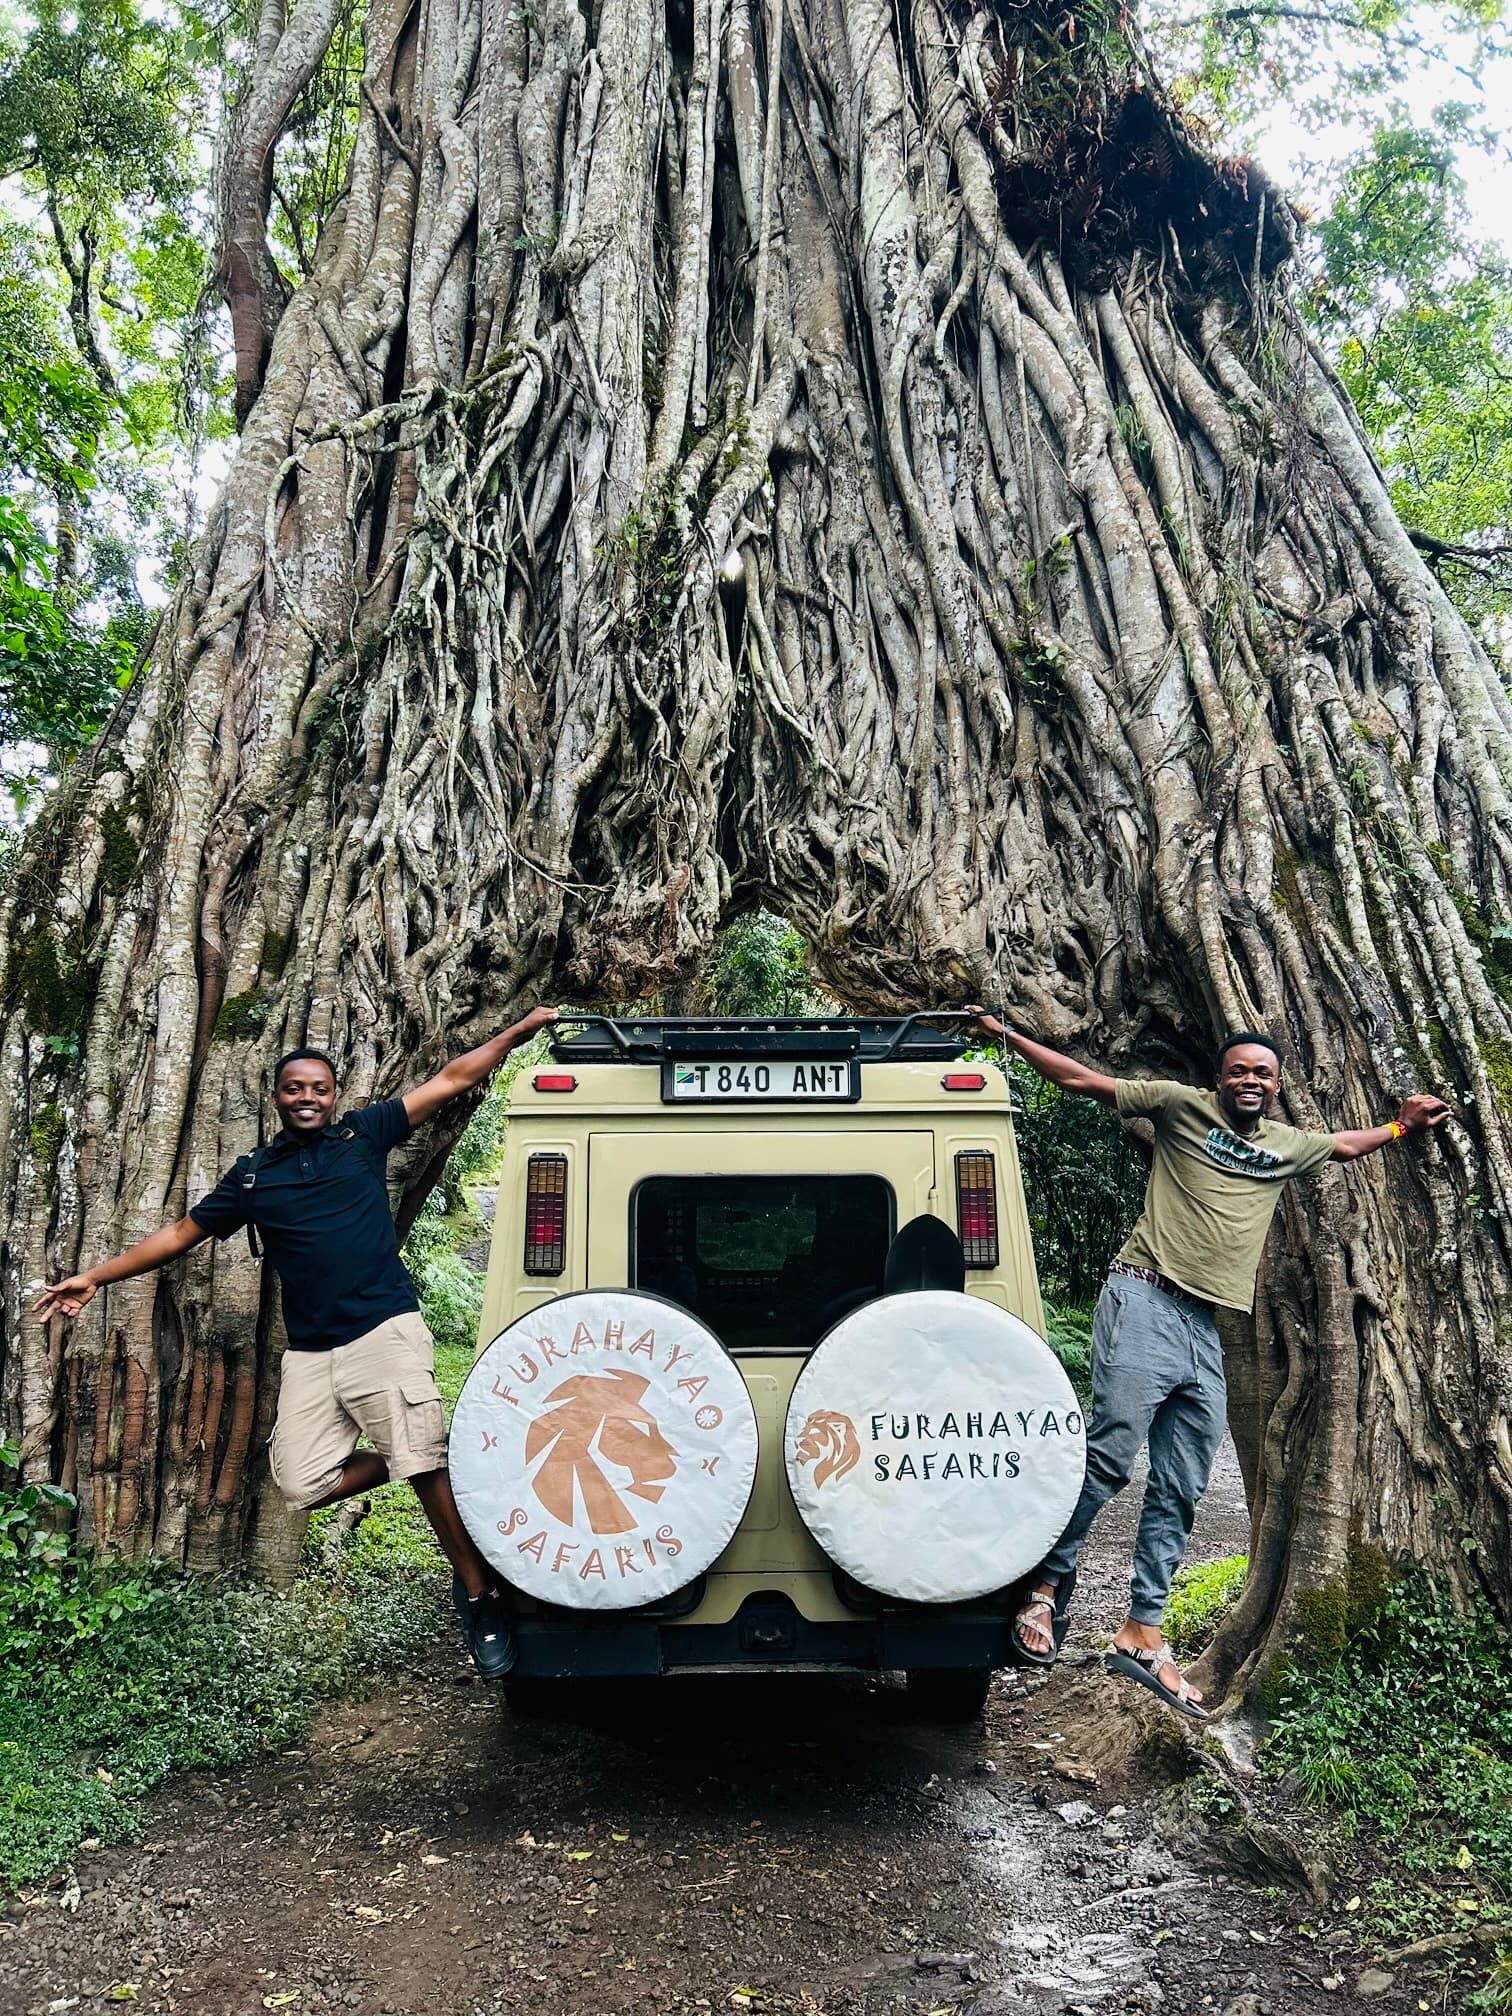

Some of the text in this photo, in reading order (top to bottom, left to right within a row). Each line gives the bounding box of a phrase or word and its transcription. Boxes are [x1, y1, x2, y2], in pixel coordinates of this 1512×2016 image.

[695, 1065, 844, 1093] T 840 ANT
[491, 1319, 723, 1430] FURAHAYAO
[871, 1409, 1081, 1441] FURAHAYAO
[874, 1451, 1021, 1482] SAFARIS
[496, 1507, 683, 1581] SAFARIS
